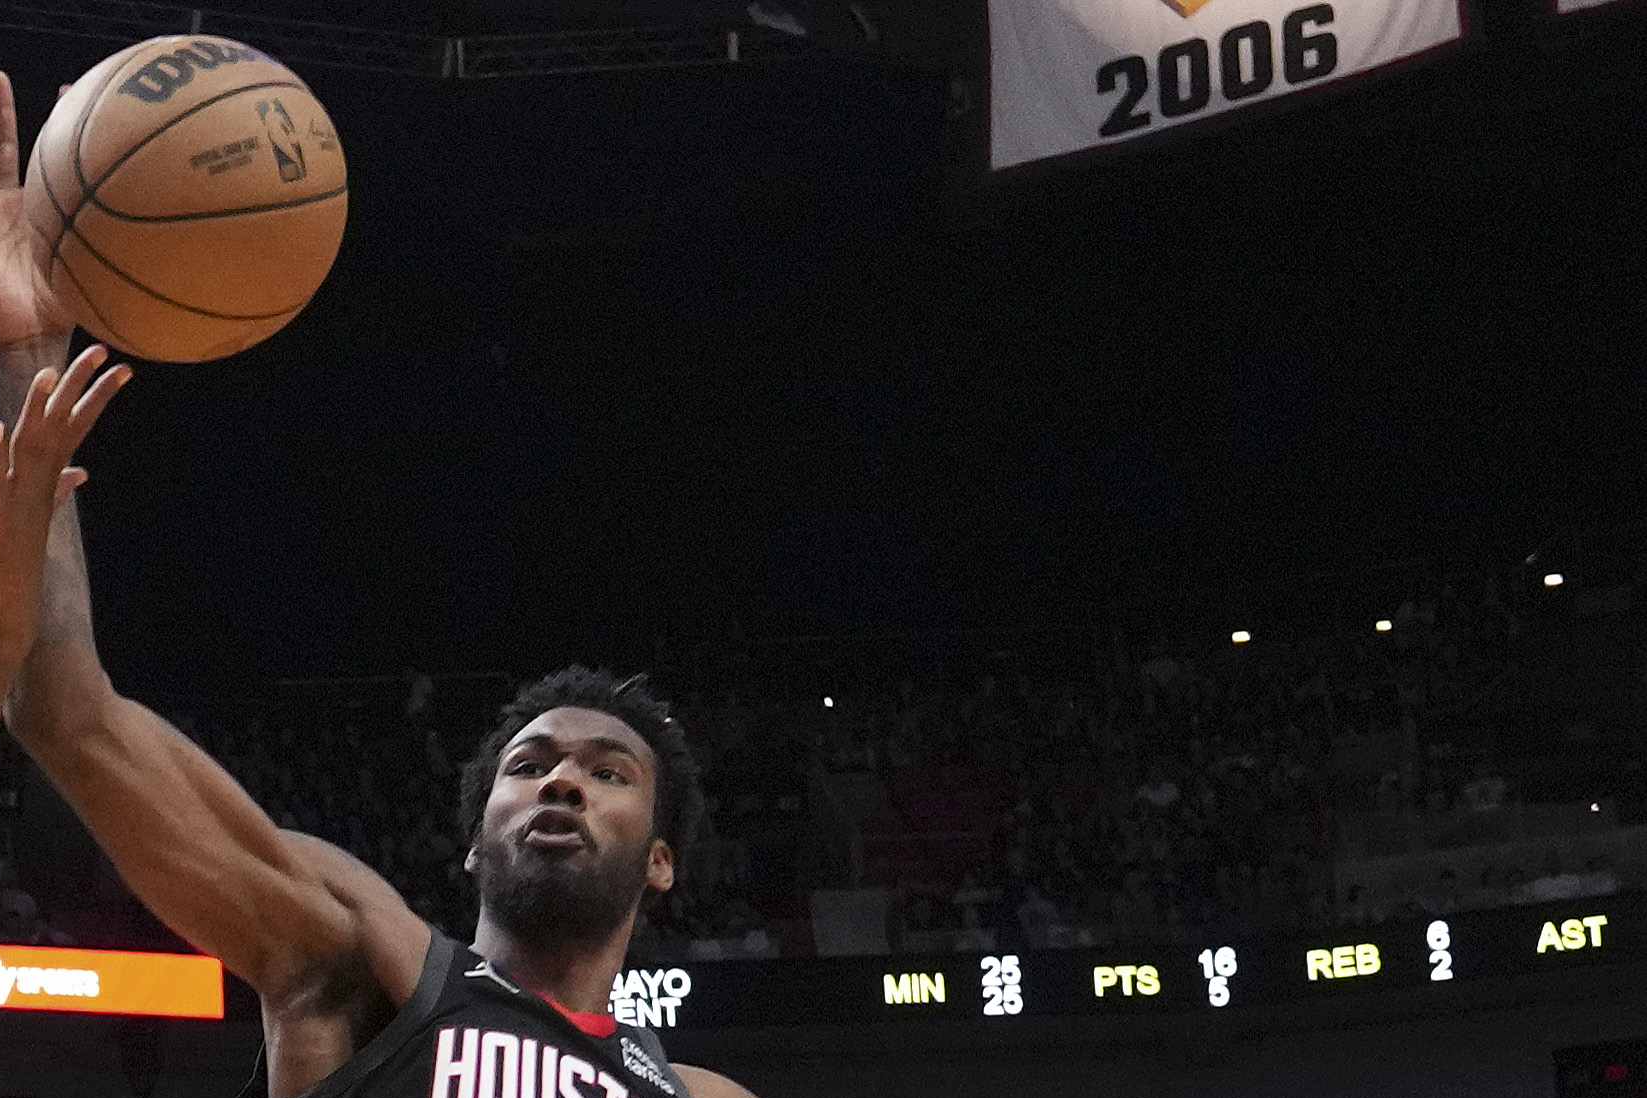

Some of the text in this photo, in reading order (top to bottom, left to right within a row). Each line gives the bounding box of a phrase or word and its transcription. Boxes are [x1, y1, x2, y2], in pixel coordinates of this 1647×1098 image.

[1095, 3, 1338, 139] 2006
[1425, 919, 1451, 950] 6
[1536, 914, 1608, 954] AST
[980, 954, 1022, 986] 25
[1197, 946, 1238, 979] 16
[1306, 943, 1382, 981] REB
[1428, 950, 1454, 982] 2
[882, 972, 946, 1005] MIN
[1093, 965, 1161, 998] PTS
[1208, 976, 1231, 1007] 5
[607, 997, 683, 1028] ENT
[982, 984, 1024, 1016] 25
